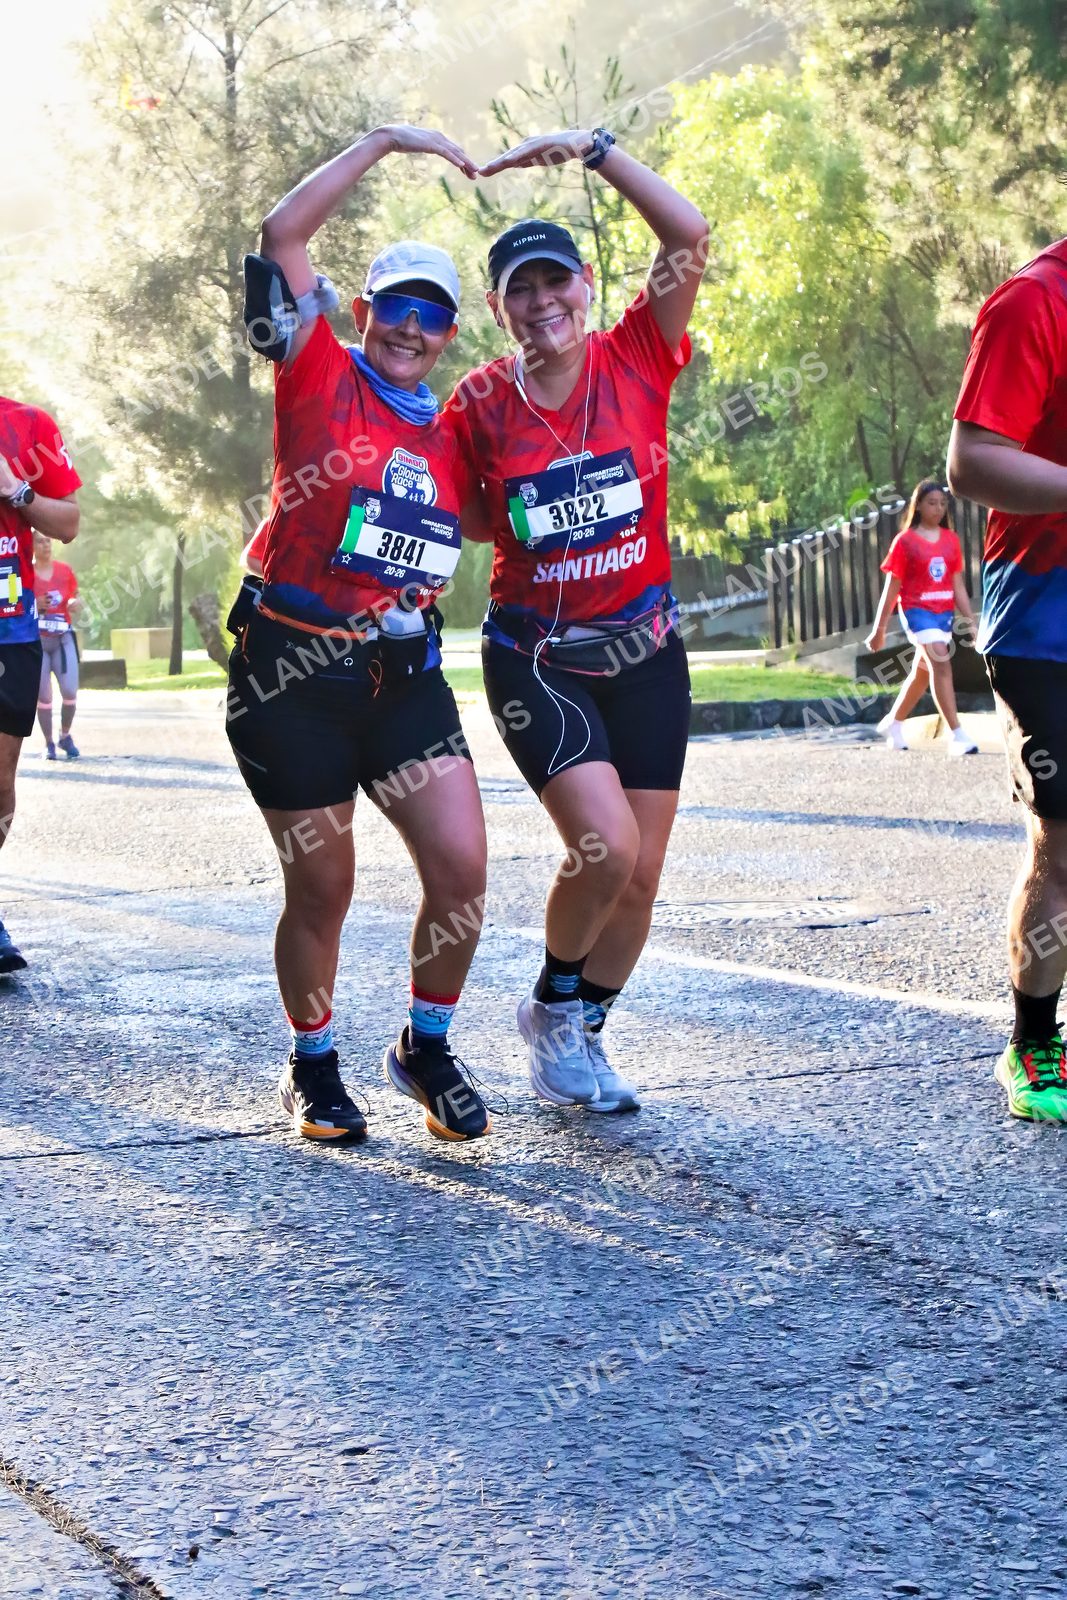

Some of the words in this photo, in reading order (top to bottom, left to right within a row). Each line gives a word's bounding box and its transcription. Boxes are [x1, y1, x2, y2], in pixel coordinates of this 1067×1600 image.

[512, 233, 546, 248] KIPRUN
[391, 472, 414, 489] Race
[397, 465, 423, 484] Global
[548, 492, 609, 531] 3822
[572, 526, 595, 541] 20-26
[619, 526, 637, 539] 10K
[376, 531, 427, 568] 3841
[533, 536, 647, 584] SANTIAGO
